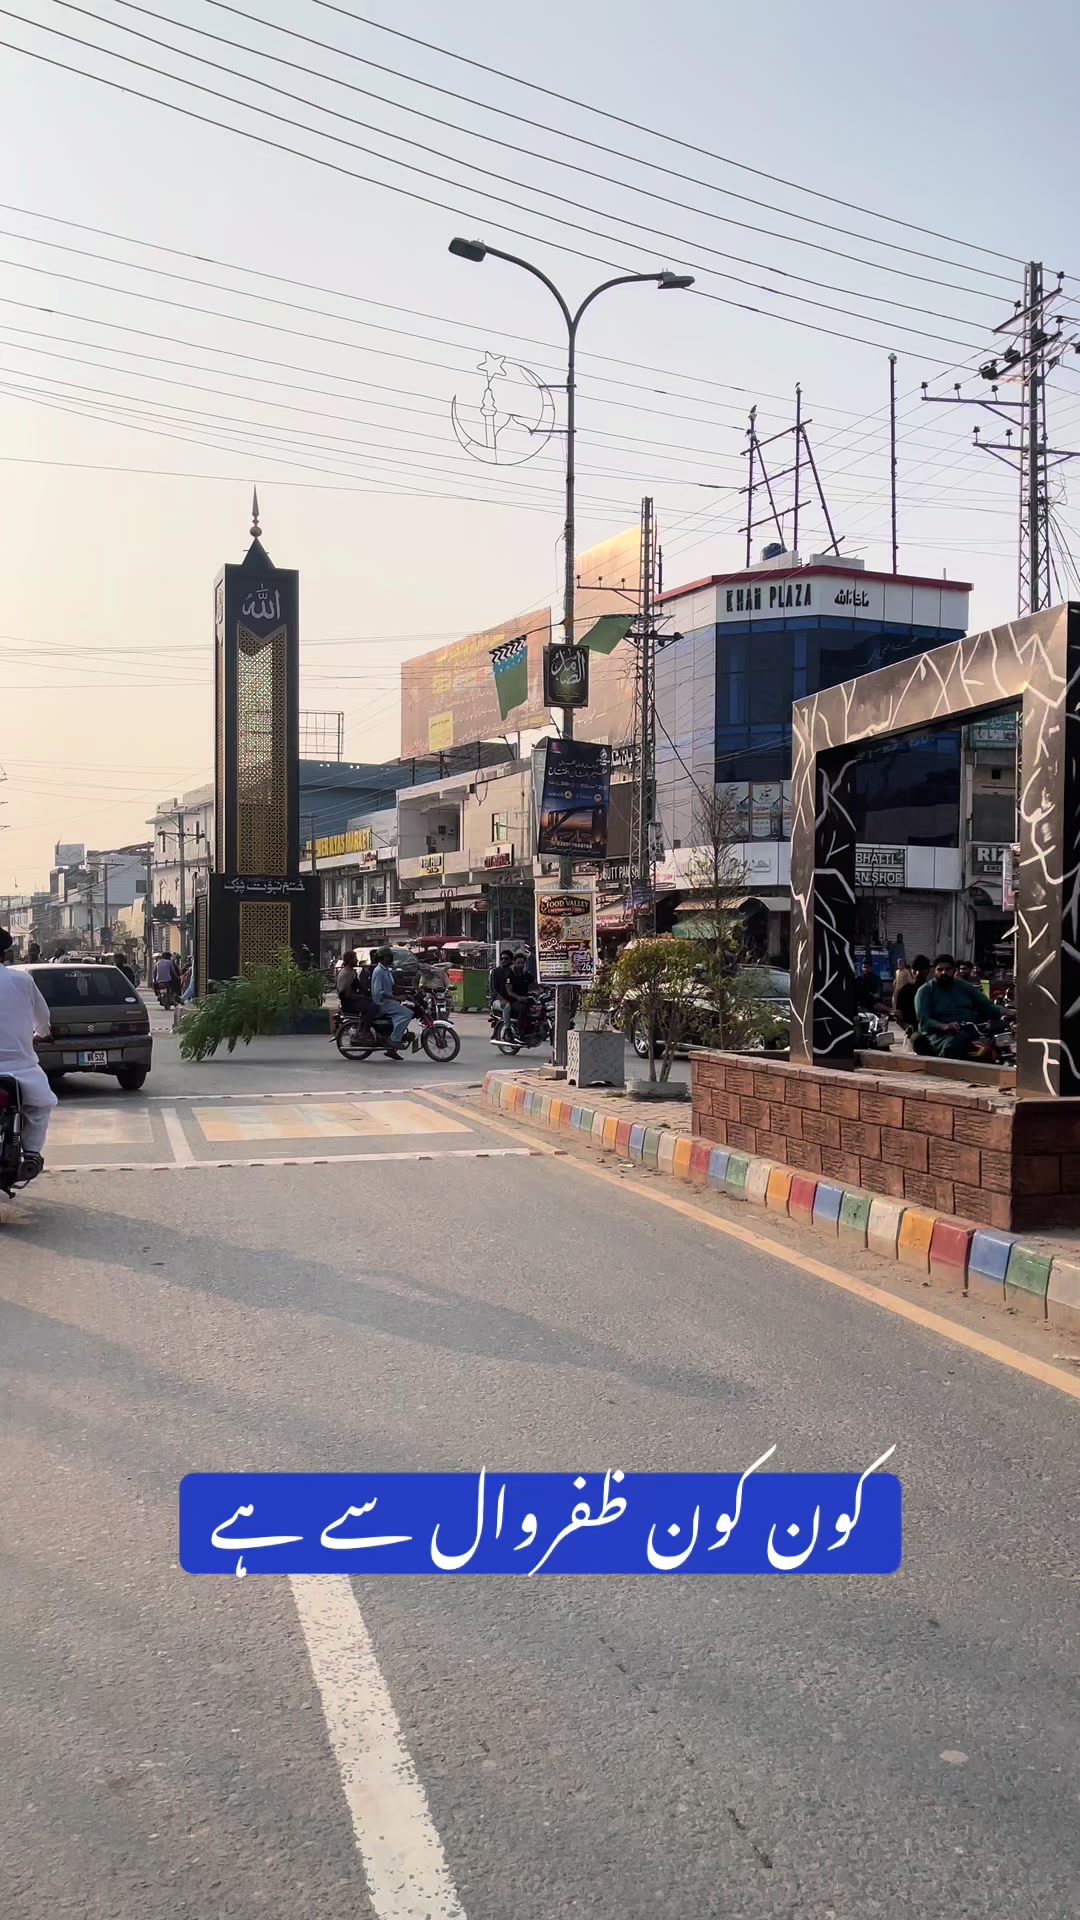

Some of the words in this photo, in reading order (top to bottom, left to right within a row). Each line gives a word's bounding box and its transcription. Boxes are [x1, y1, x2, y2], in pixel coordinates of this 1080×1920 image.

[726, 588, 761, 612] KHAN
[769, 583, 812, 608] PLAZA
[346, 826, 370, 854] MARKET
[855, 852, 895, 865] BHATTI
[977, 847, 1004, 862] RIZ
[871, 872, 904, 883] SHOP
[541, 939, 557, 949] 1800
